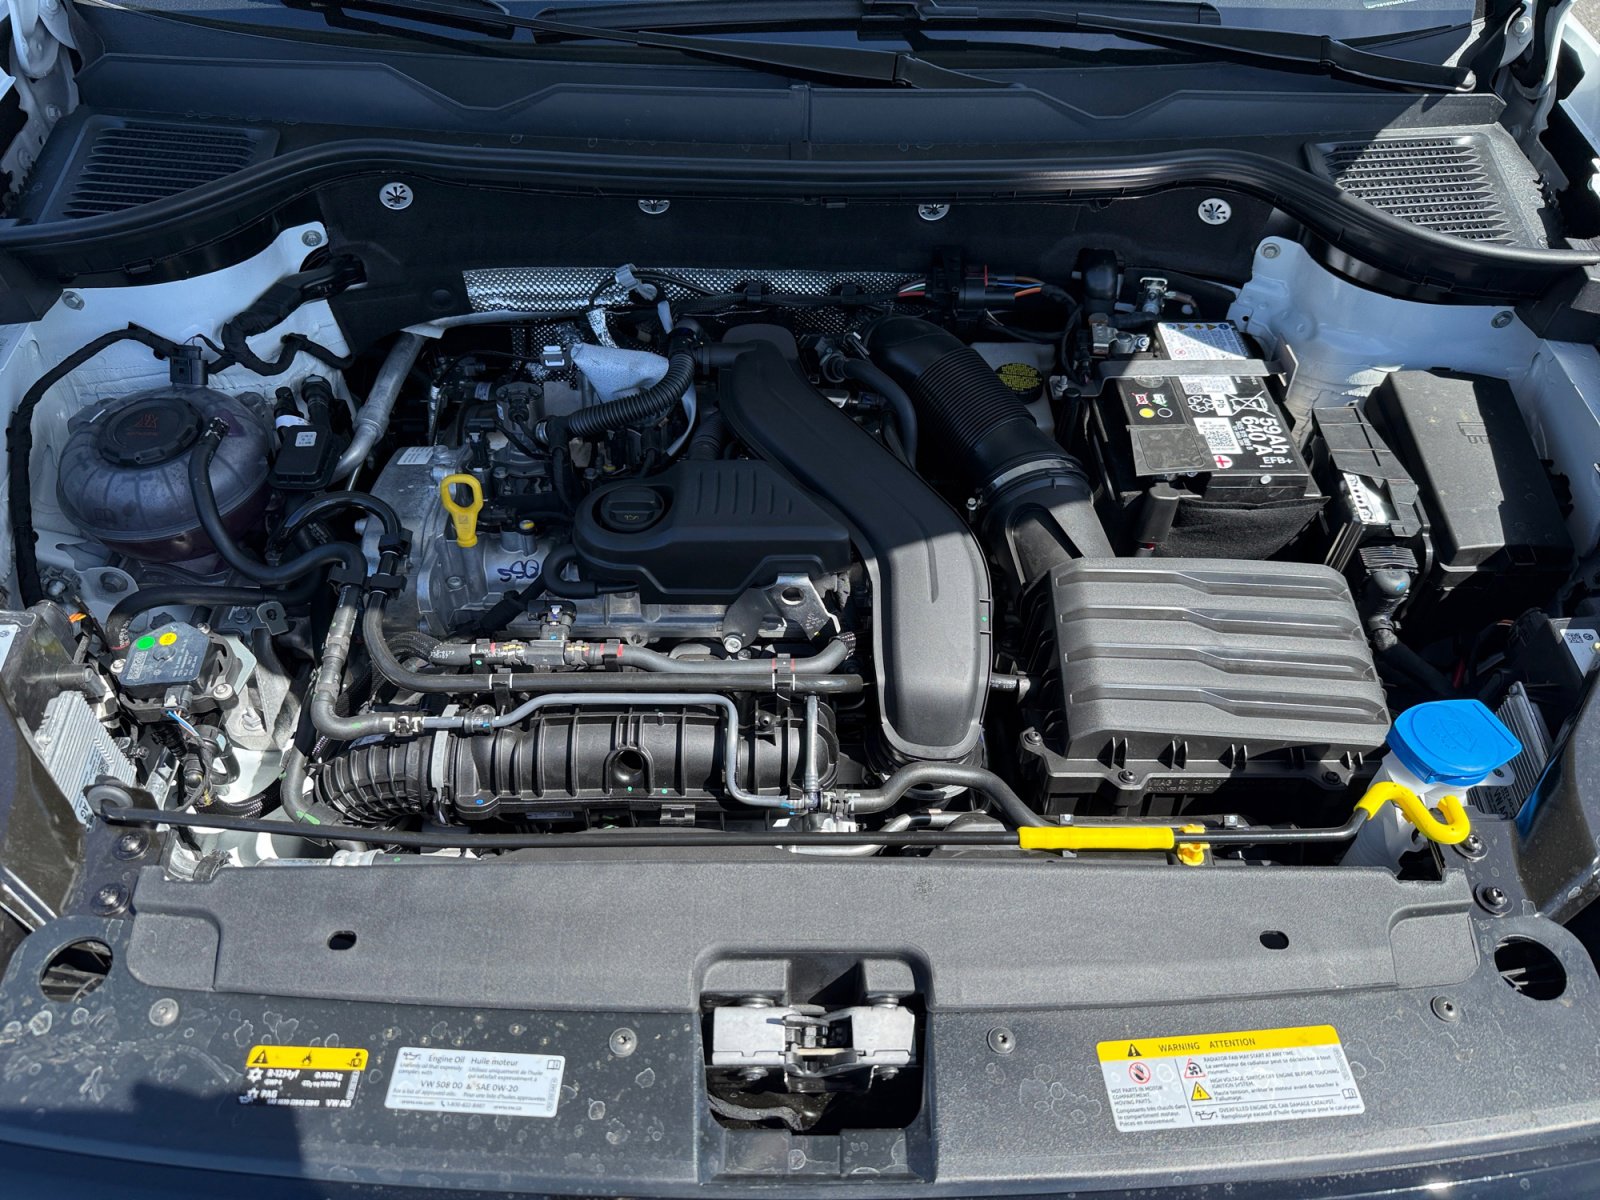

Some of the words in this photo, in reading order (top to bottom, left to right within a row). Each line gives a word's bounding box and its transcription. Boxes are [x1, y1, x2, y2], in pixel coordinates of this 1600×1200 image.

[1241, 416, 1267, 441] 640
[1260, 417, 1290, 454] 59Ah
[1253, 444, 1273, 456] A
[1262, 456, 1294, 464] EFB+
[1158, 1041, 1200, 1052] WARNING
[1209, 1038, 1256, 1048] ATTENTION
[428, 1055, 453, 1064] Engine
[260, 1090, 278, 1098] PAG
